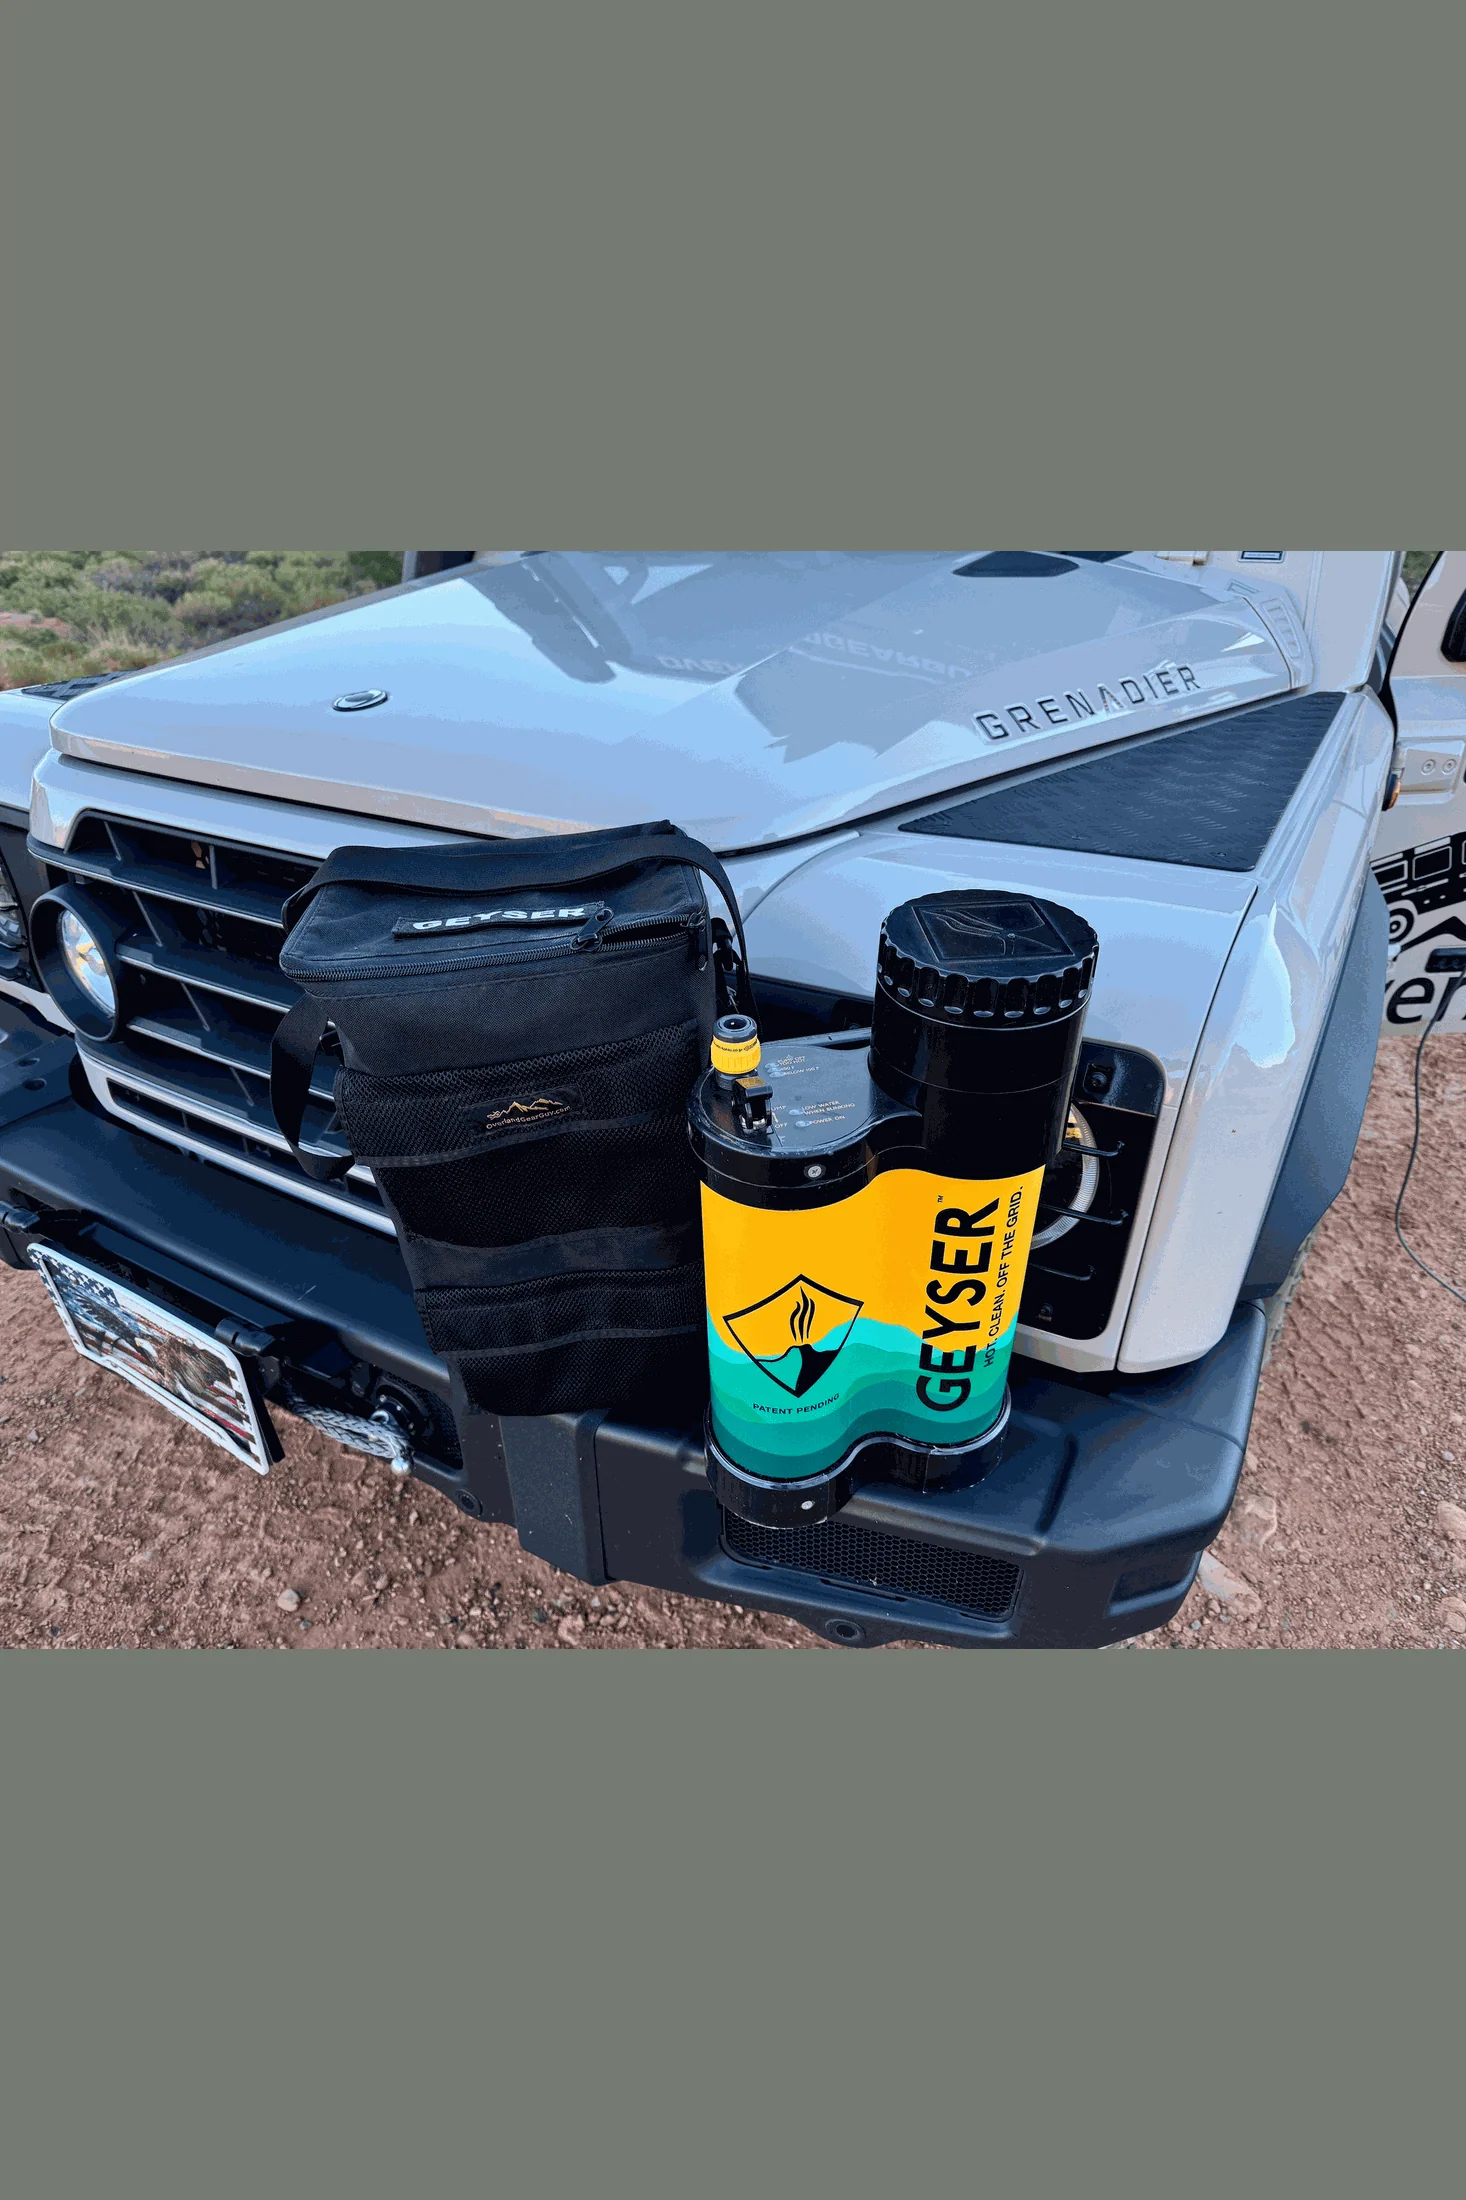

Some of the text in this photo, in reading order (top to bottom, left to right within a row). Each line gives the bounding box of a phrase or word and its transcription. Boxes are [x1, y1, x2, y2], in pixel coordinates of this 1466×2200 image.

[975, 664, 1201, 741] GRENADIER
[412, 907, 586, 931] GEYSER
[804, 1103, 856, 1116] WHEN BLINKING
[817, 1100, 840, 1108] WATER
[486, 1105, 571, 1130] OverlandGearGuy.com
[808, 1117, 833, 1125] POWER
[983, 1186, 1023, 1367] HOT. CLEAN. OFF THE GRID.
[916, 1197, 1000, 1412] GEYSER
[753, 1392, 840, 1415] PATENT PENDING
